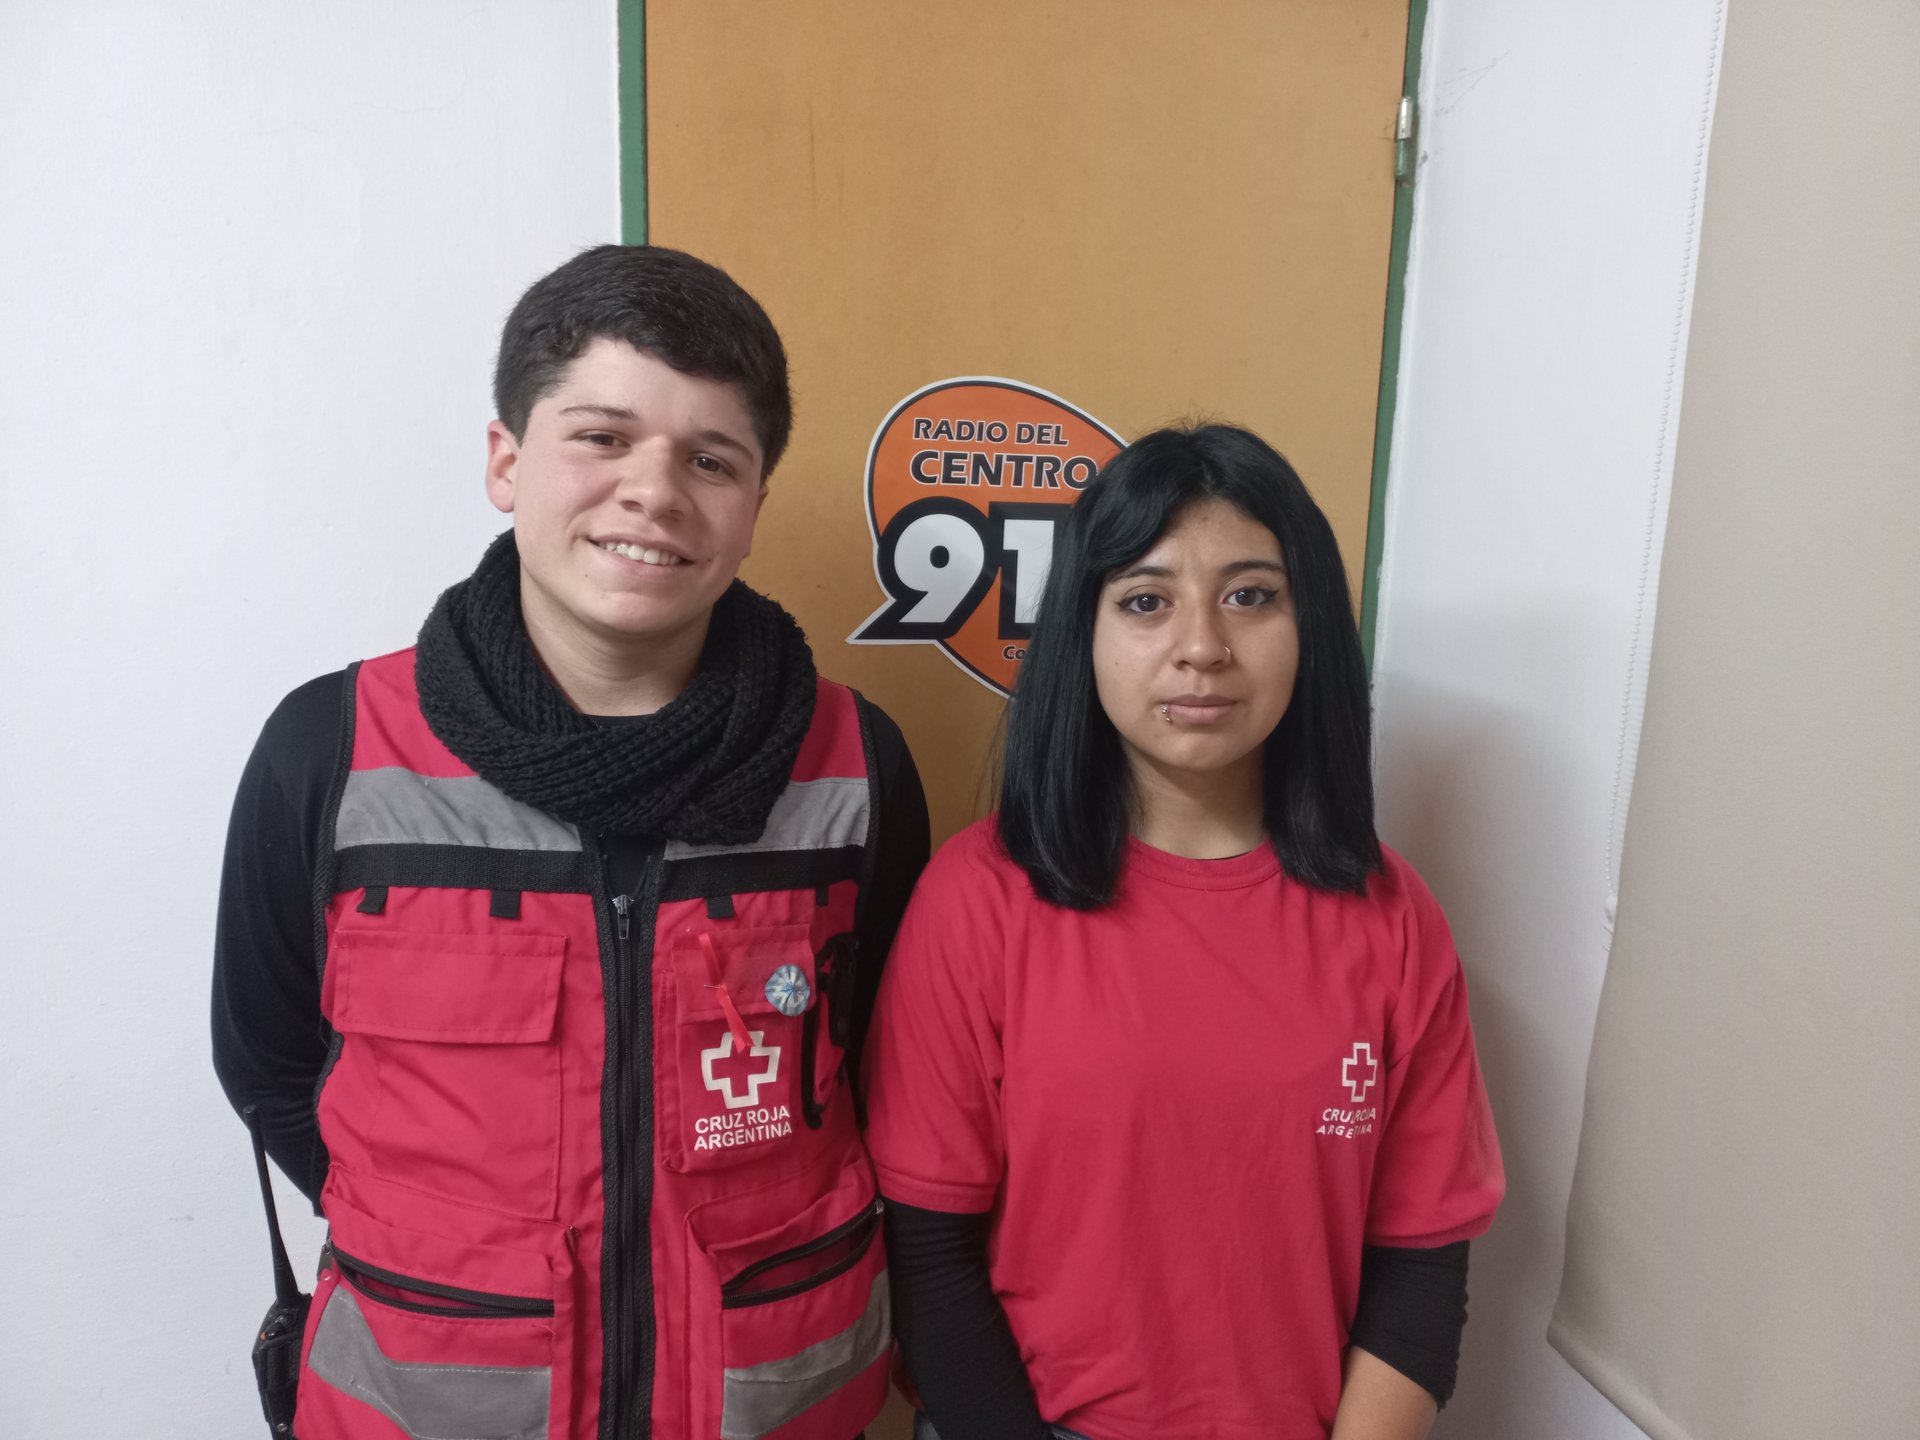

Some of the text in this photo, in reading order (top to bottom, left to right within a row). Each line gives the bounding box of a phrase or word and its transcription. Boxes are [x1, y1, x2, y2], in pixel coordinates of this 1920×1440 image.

[913, 417, 1069, 446] RADIO DEL
[909, 449, 1099, 490] CENTRO
[694, 1104, 791, 1134] CRUZ ROJA
[1315, 1123, 1372, 1139] ARGETINA
[693, 1121, 793, 1152] ARGENTINA
